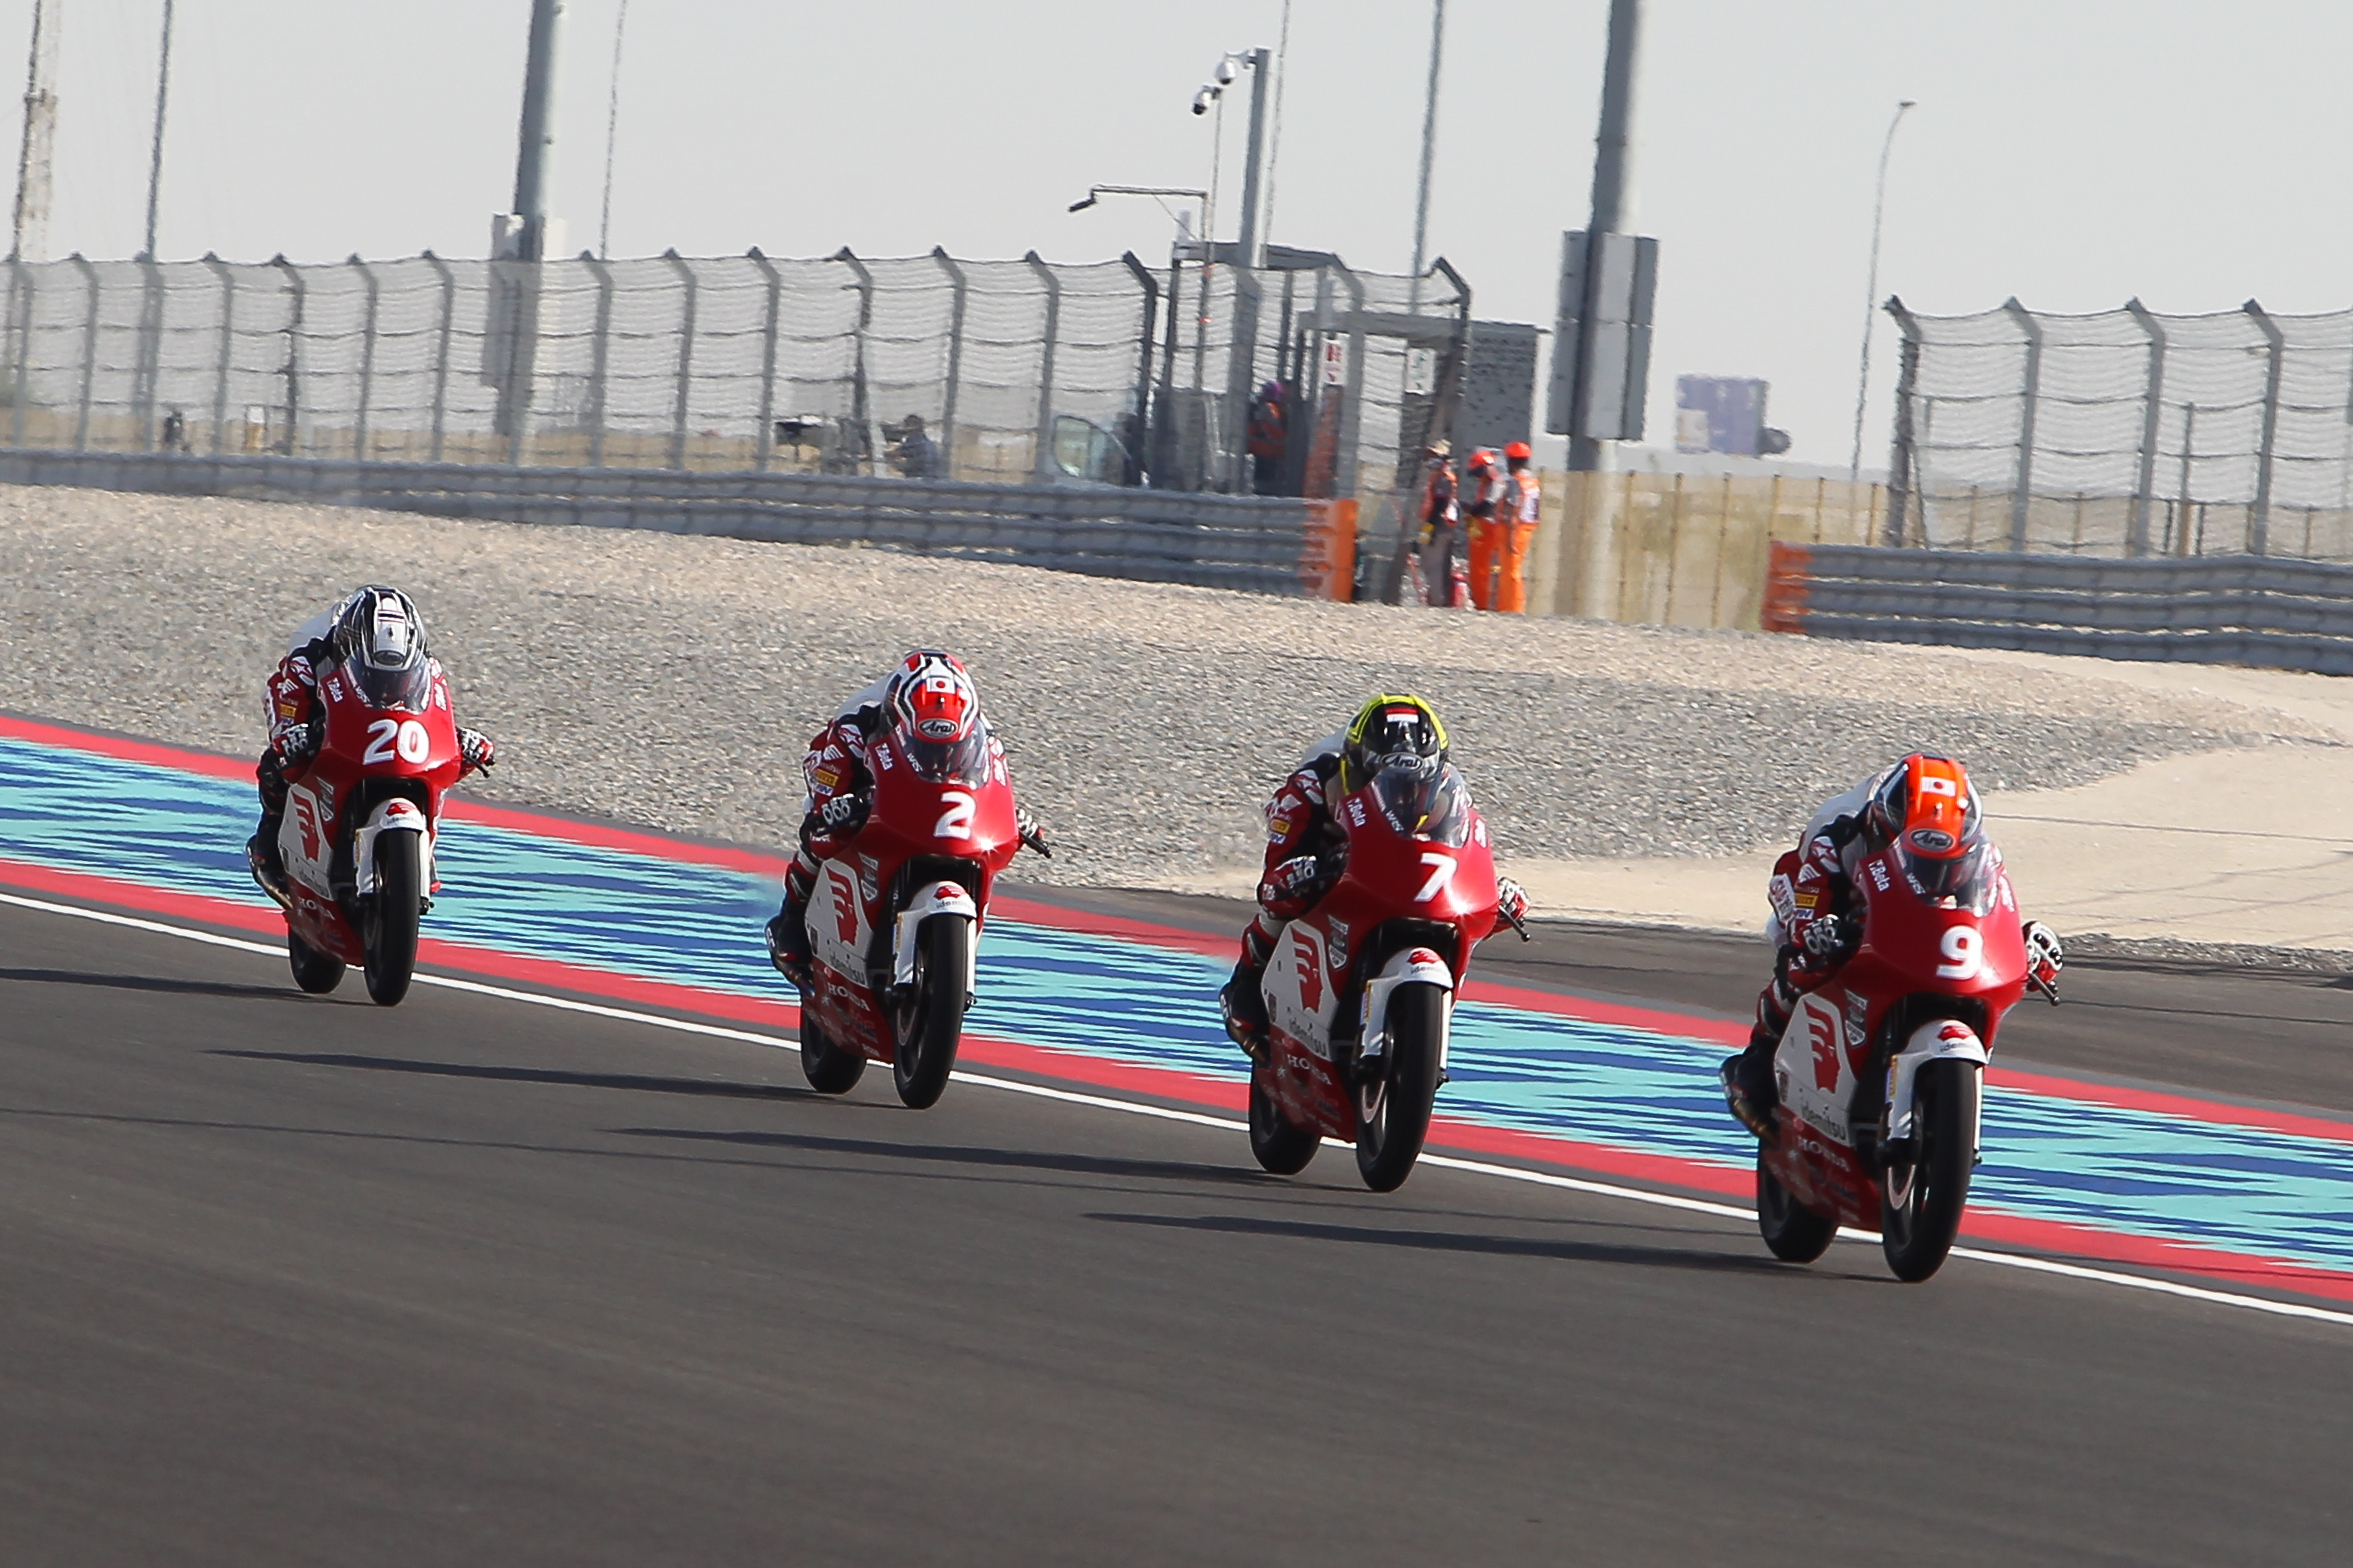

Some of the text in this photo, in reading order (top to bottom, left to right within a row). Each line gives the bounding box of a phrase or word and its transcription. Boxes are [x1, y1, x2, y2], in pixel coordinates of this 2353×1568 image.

[363, 718, 430, 765] 20
[921, 720, 955, 734] Arai
[1384, 754, 1421, 768] Arai
[933, 790, 977, 841] 2
[1414, 852, 1458, 903] 7
[1870, 864, 1891, 892] Beta
[1936, 925, 1985, 981] 9
